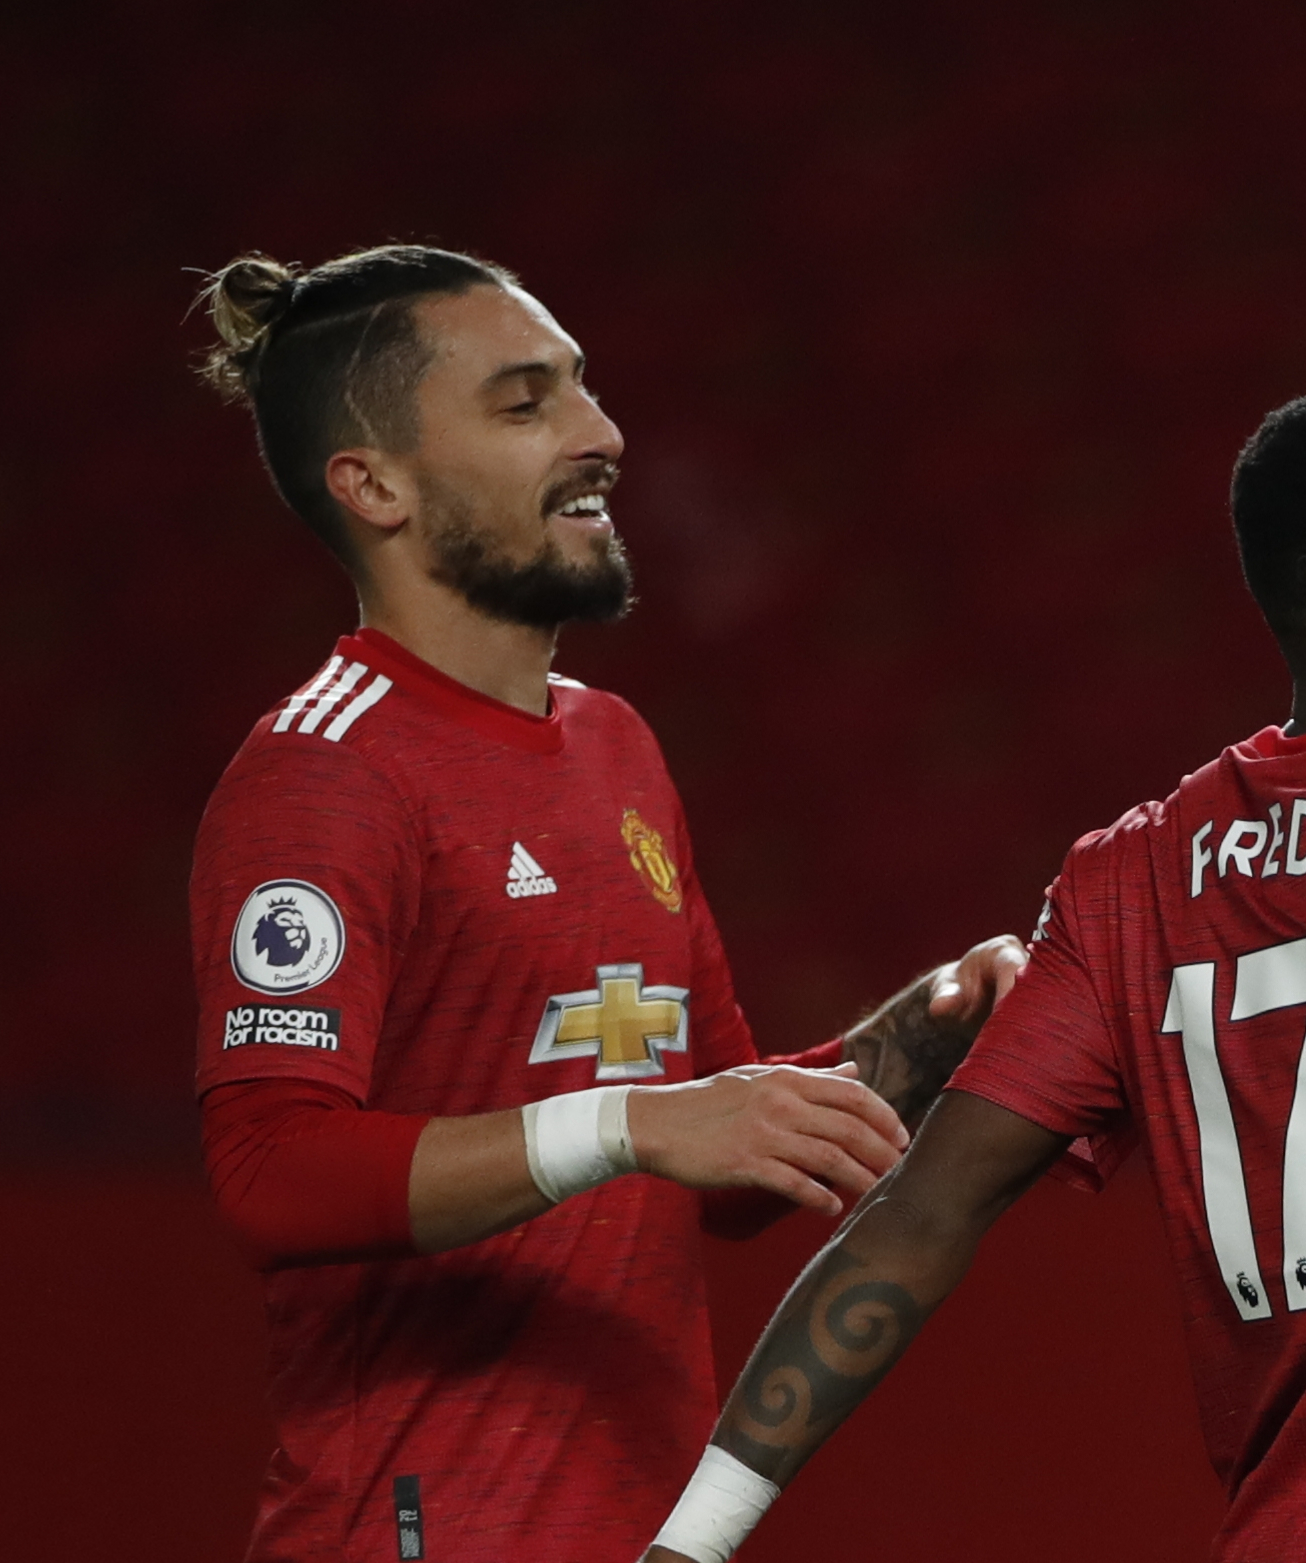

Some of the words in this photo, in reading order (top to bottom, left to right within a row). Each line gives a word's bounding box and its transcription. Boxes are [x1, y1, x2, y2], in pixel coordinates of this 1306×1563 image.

[506, 877, 558, 898] adidas
[274, 967, 310, 983] Premier
[309, 937, 328, 971] League
[225, 1006, 254, 1031] No
[258, 1007, 328, 1030] room
[223, 1026, 252, 1050] for
[254, 1026, 338, 1051] racism
